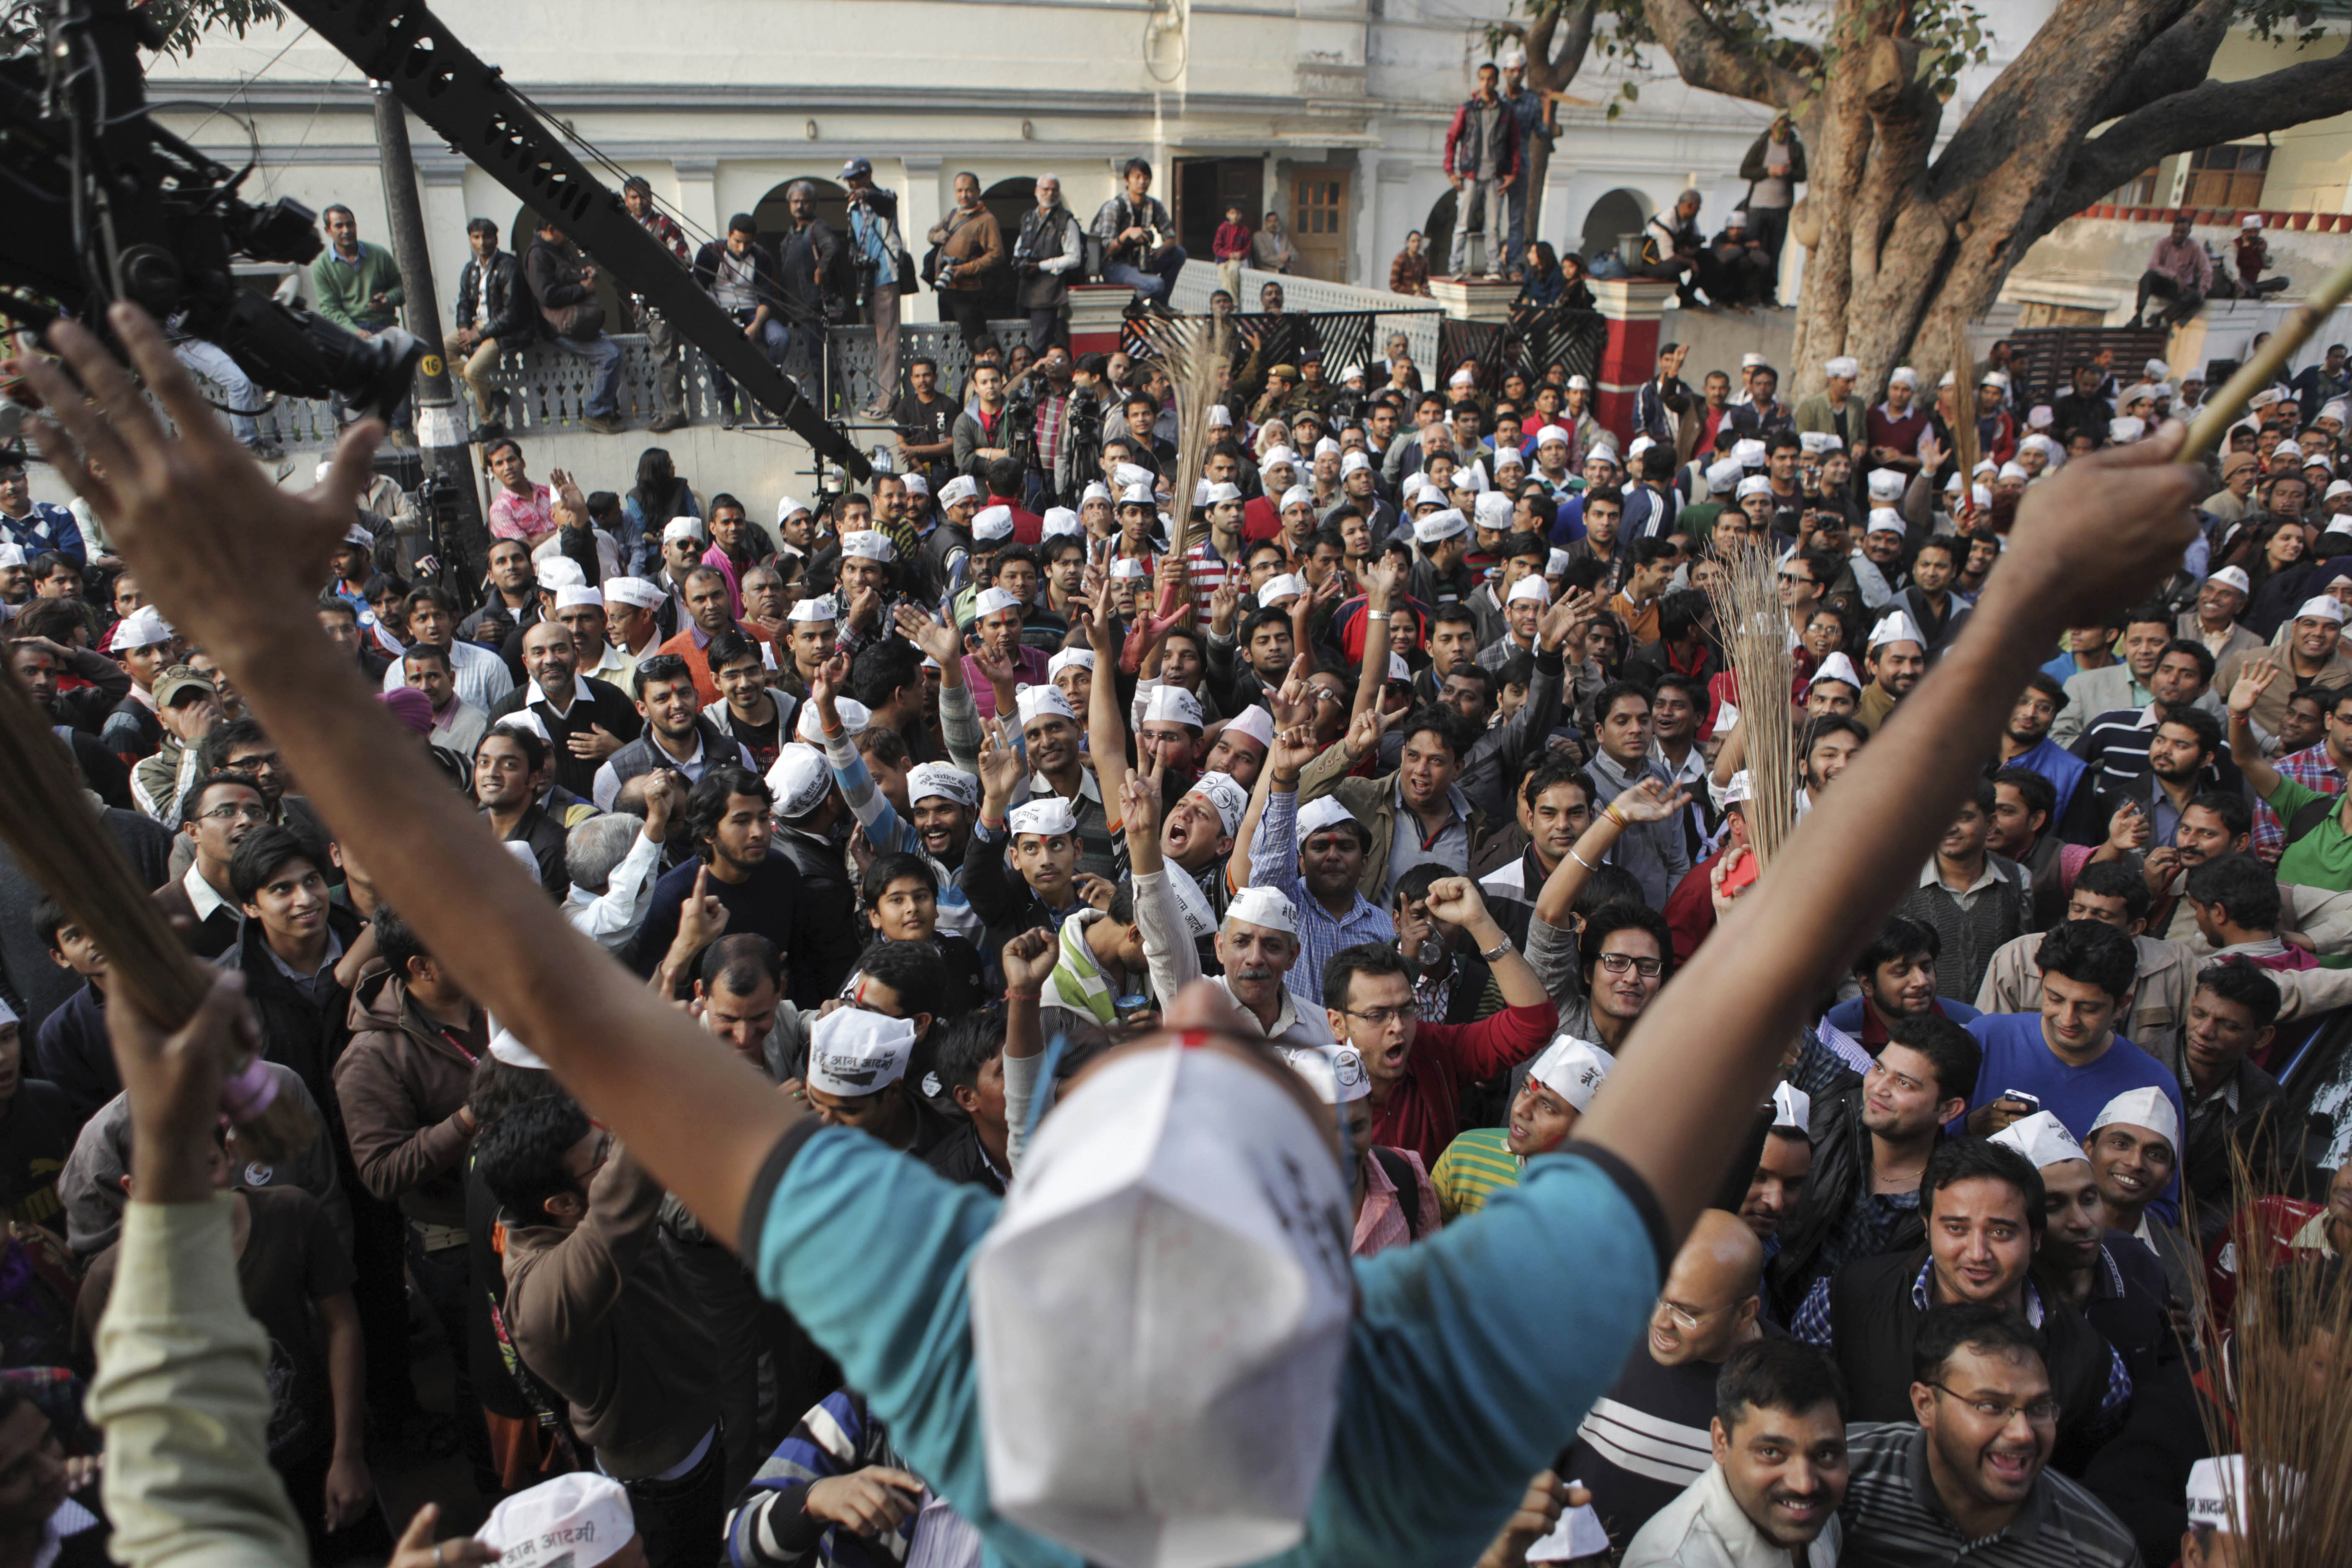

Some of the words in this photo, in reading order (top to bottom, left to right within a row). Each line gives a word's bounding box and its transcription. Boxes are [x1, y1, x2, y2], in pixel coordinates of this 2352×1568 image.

[426, 359, 438, 371] 16
[1185, 913, 1207, 934] आदमी
[831, 1055, 857, 1067] आम
[861, 1058, 893, 1070] आदमी
[542, 1521, 595, 1549] आदमी
